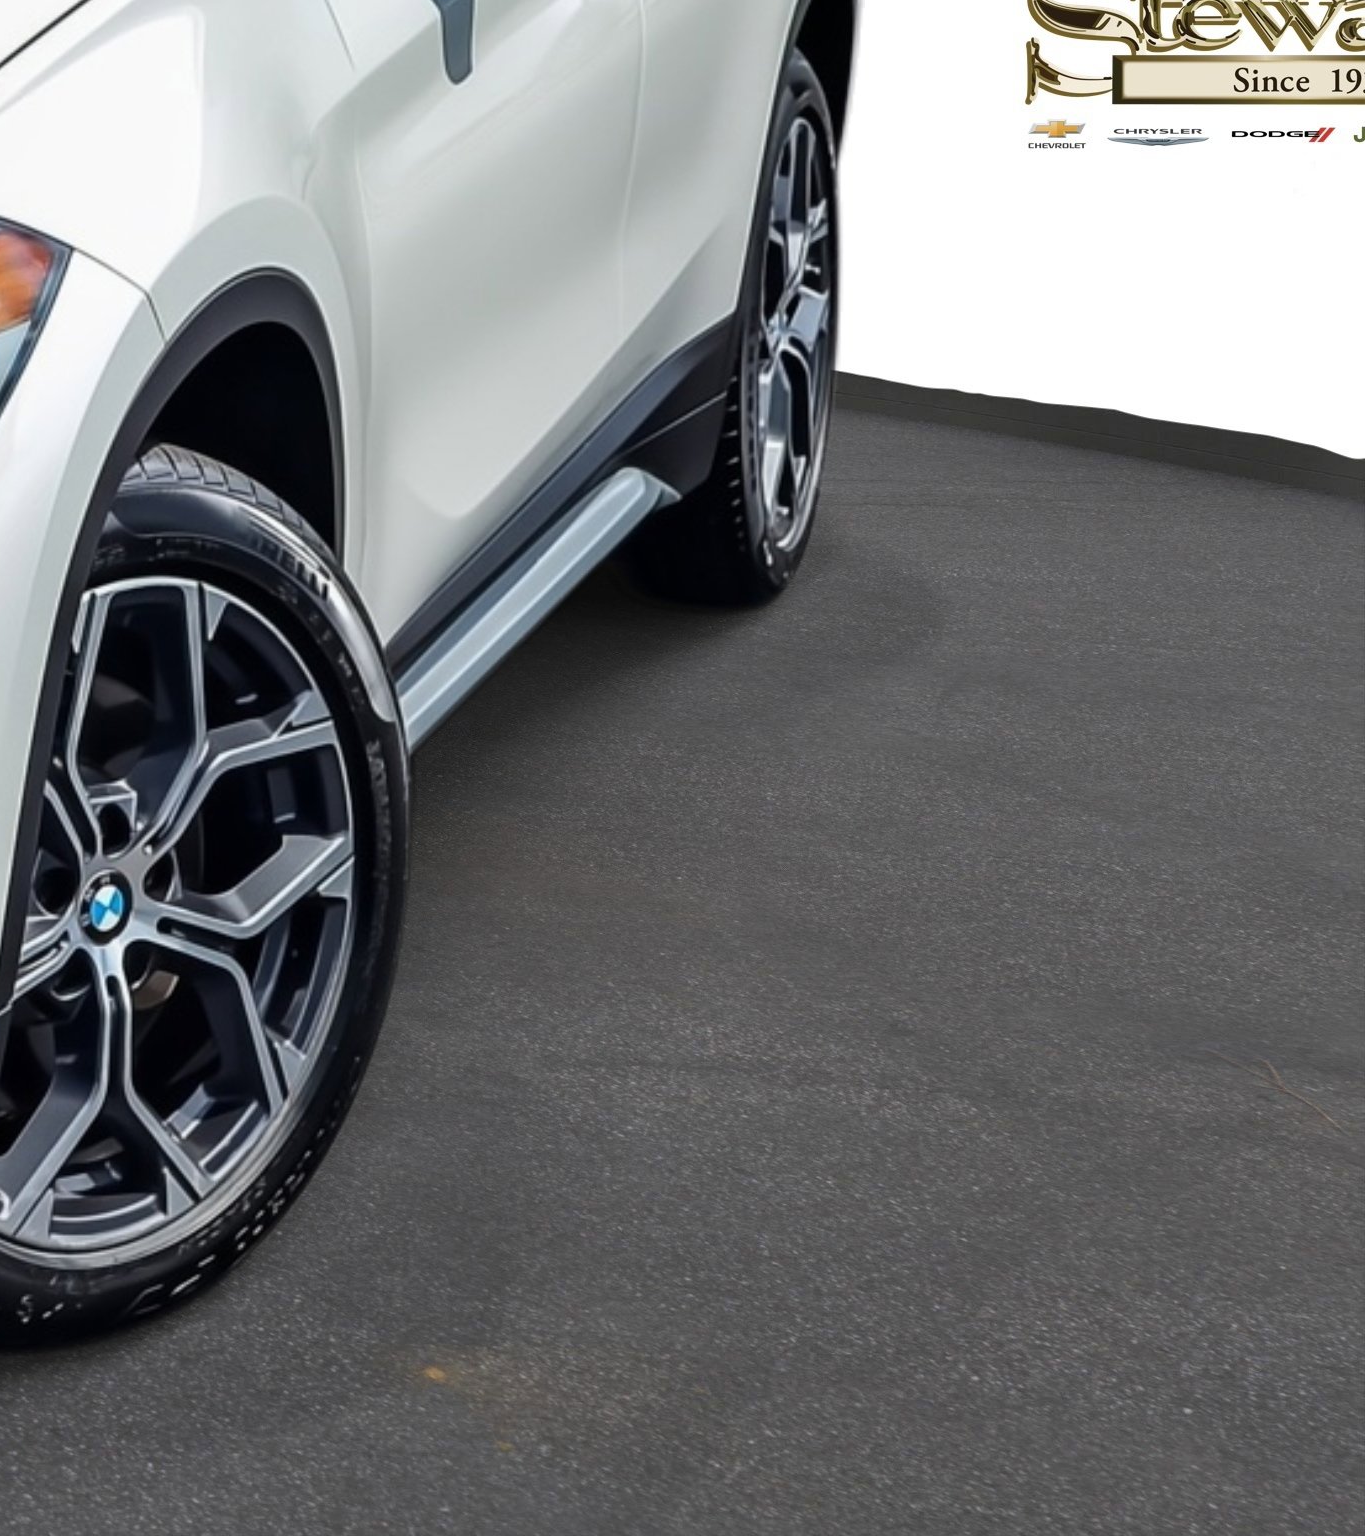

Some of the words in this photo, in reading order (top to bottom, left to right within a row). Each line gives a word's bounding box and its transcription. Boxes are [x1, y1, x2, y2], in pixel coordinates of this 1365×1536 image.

[1233, 66, 1310, 93] Since
[1332, 67, 1365, 94] 19
[1113, 127, 1203, 135] CHRYSLER
[1232, 130, 1320, 138] DODGE
